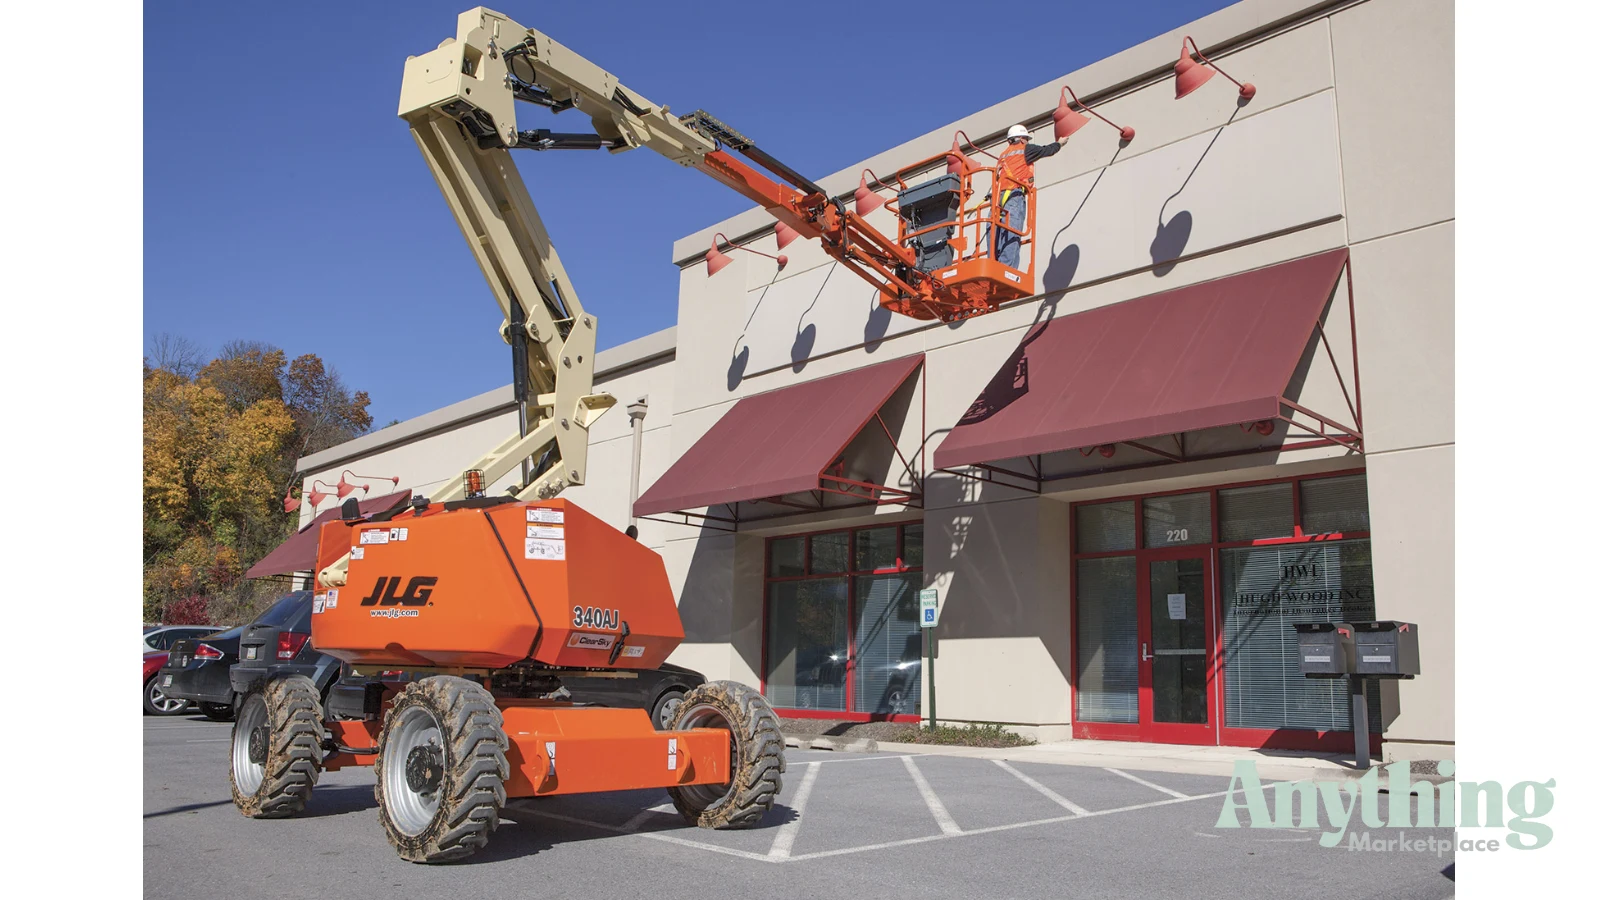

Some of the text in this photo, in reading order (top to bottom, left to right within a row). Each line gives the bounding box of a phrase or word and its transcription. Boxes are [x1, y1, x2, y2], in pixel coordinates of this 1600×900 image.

[1167, 529, 1188, 542] 220
[360, 576, 438, 606] JLG
[1283, 590, 1334, 603] WOOD
[370, 609, 419, 618] www.jlg.com
[573, 605, 619, 630] 340AJ
[579, 636, 612, 647] ClearSky
